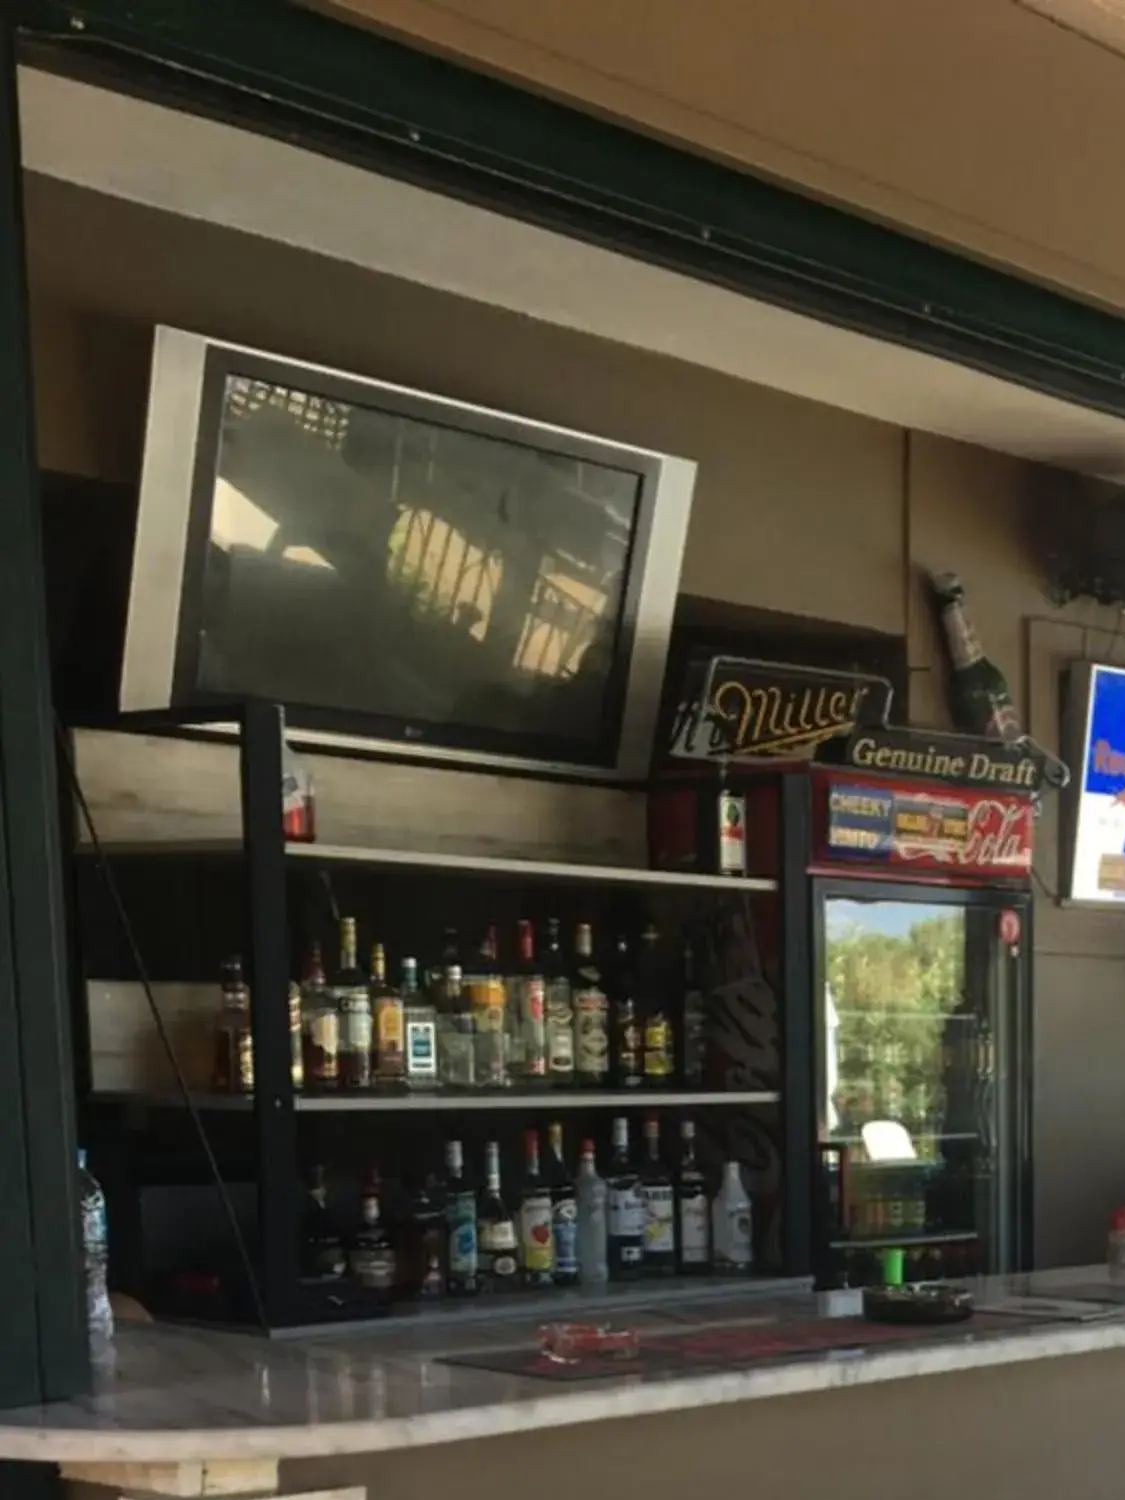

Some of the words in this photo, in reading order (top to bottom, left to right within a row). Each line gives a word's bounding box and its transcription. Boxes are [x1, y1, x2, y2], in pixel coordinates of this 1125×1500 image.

[715, 681, 869, 747] Miller
[852, 738, 967, 778] Genuine
[968, 754, 1037, 786] Draft
